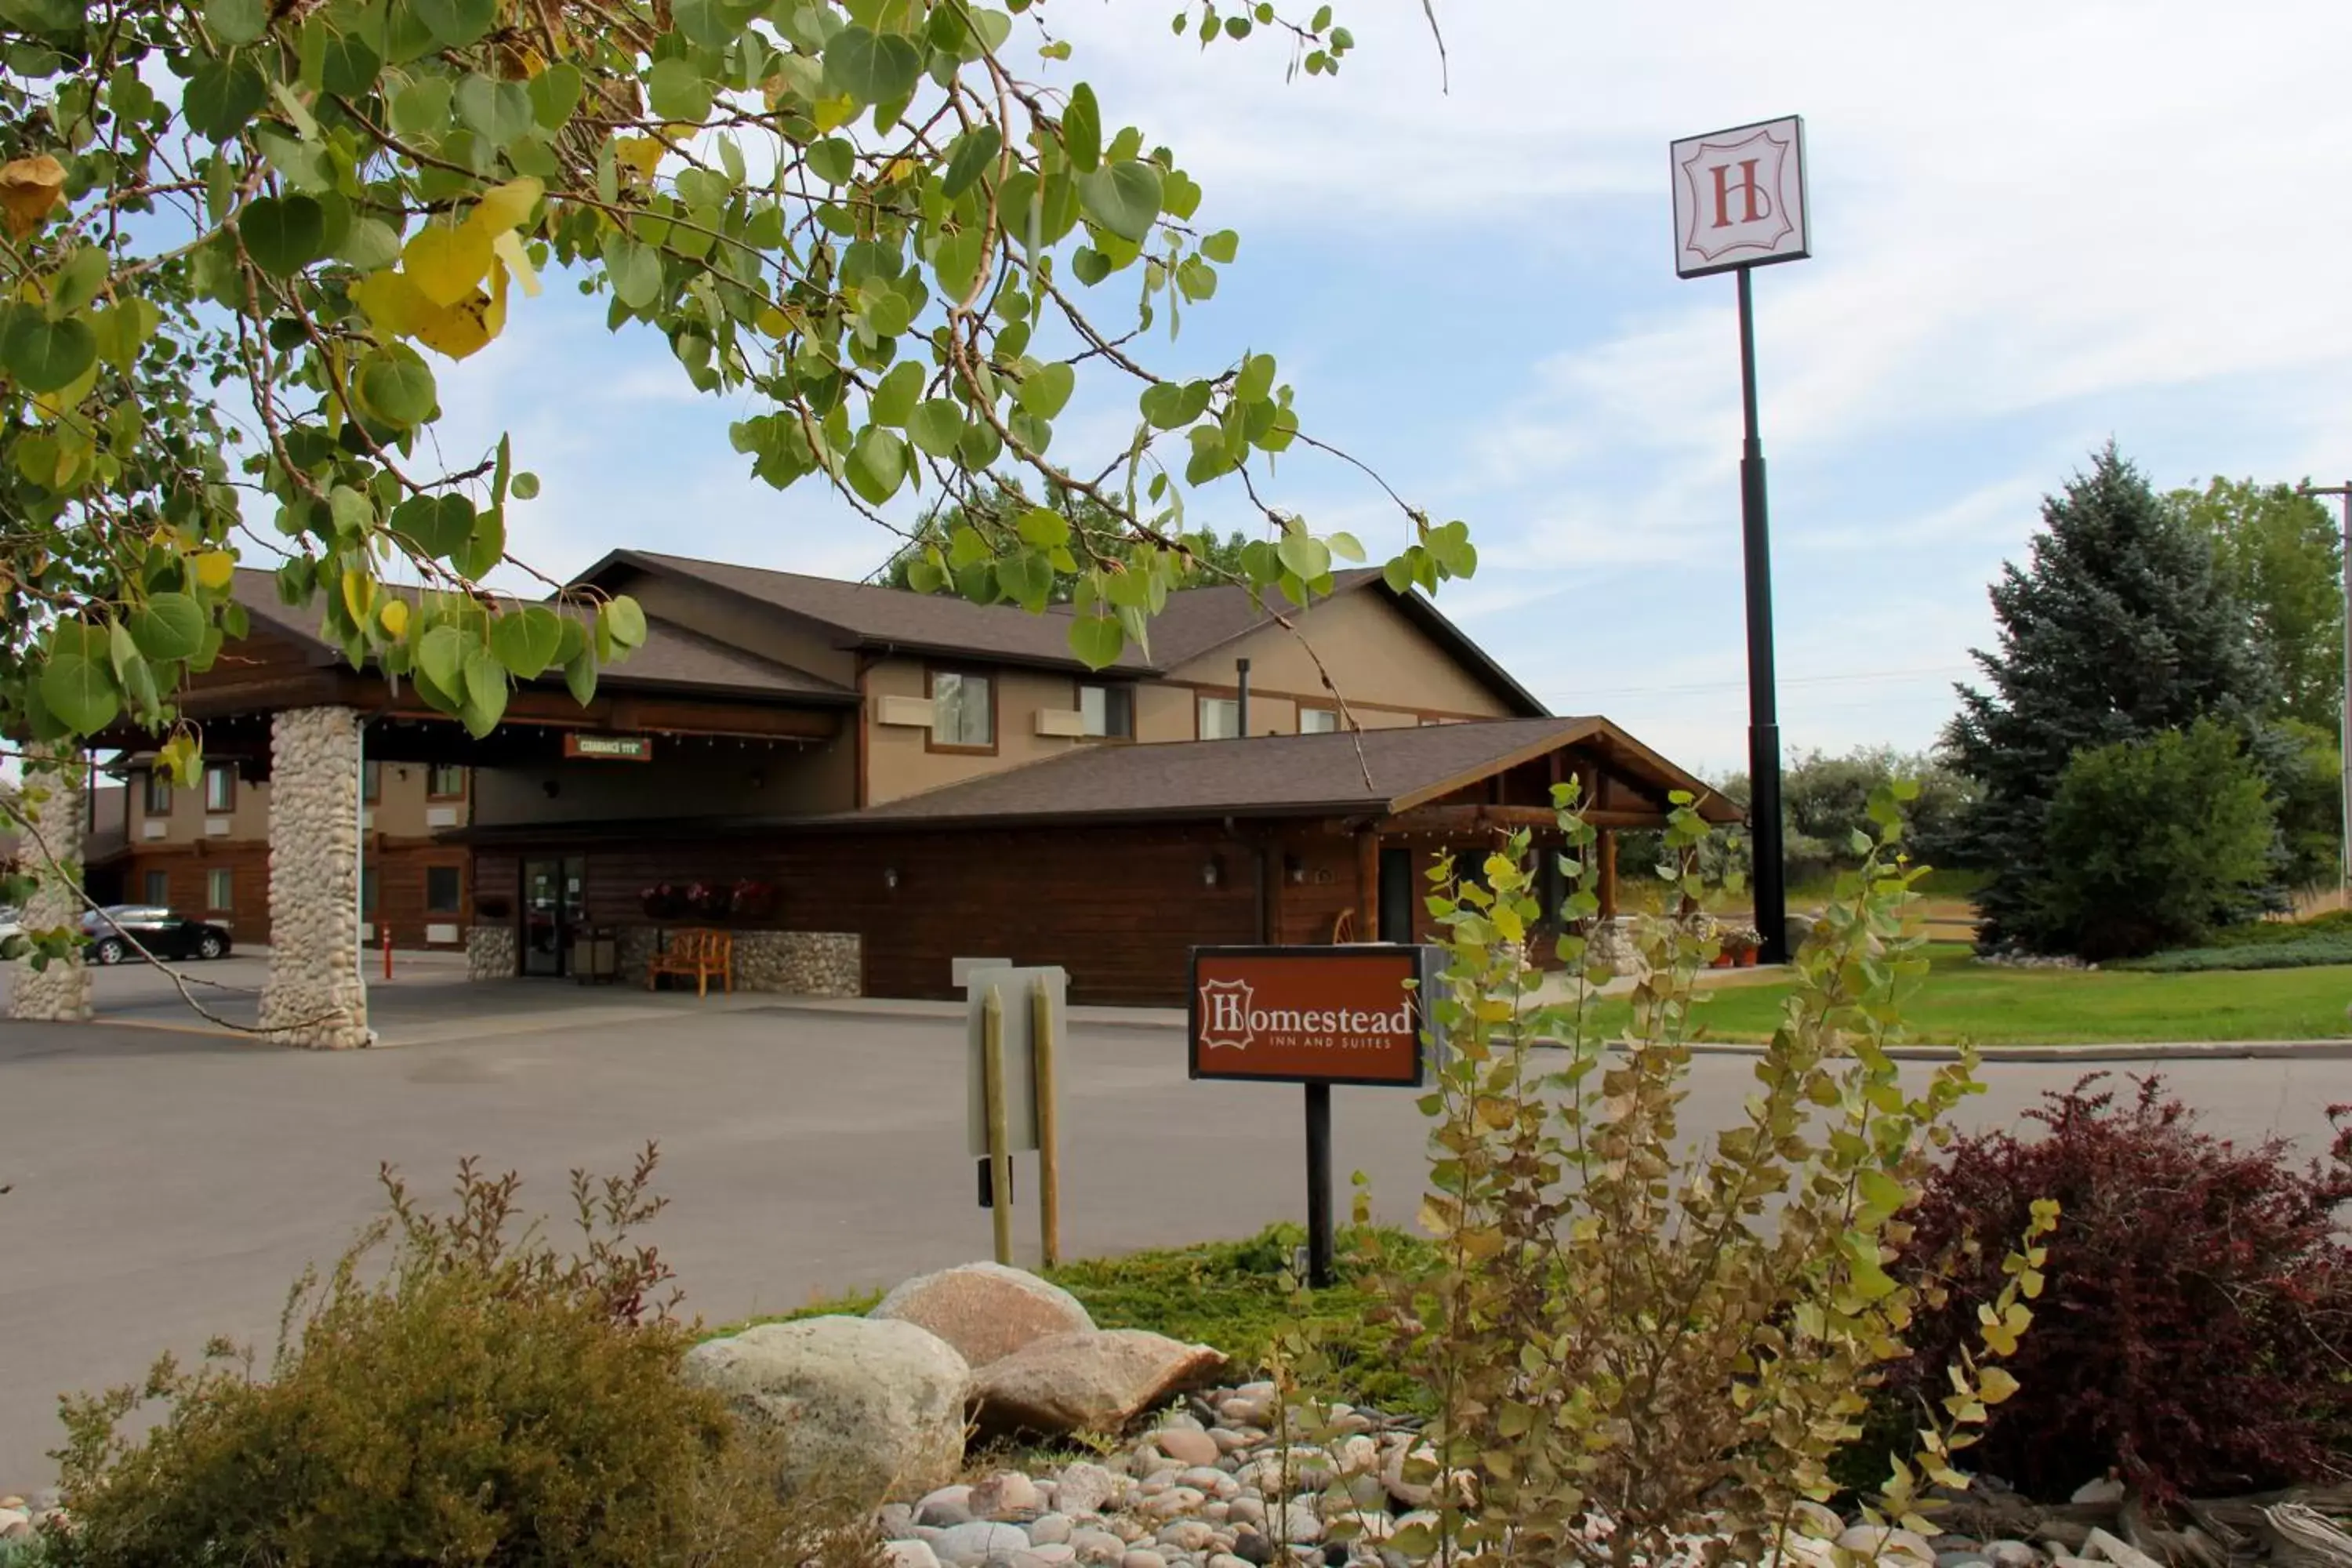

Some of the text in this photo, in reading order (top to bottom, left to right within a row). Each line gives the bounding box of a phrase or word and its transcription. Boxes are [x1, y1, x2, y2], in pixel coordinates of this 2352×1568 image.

[1708, 158, 1771, 228] H
[1212, 993, 1414, 1034] Homestead
[1269, 1036, 1392, 1049] INN AND SUITES
